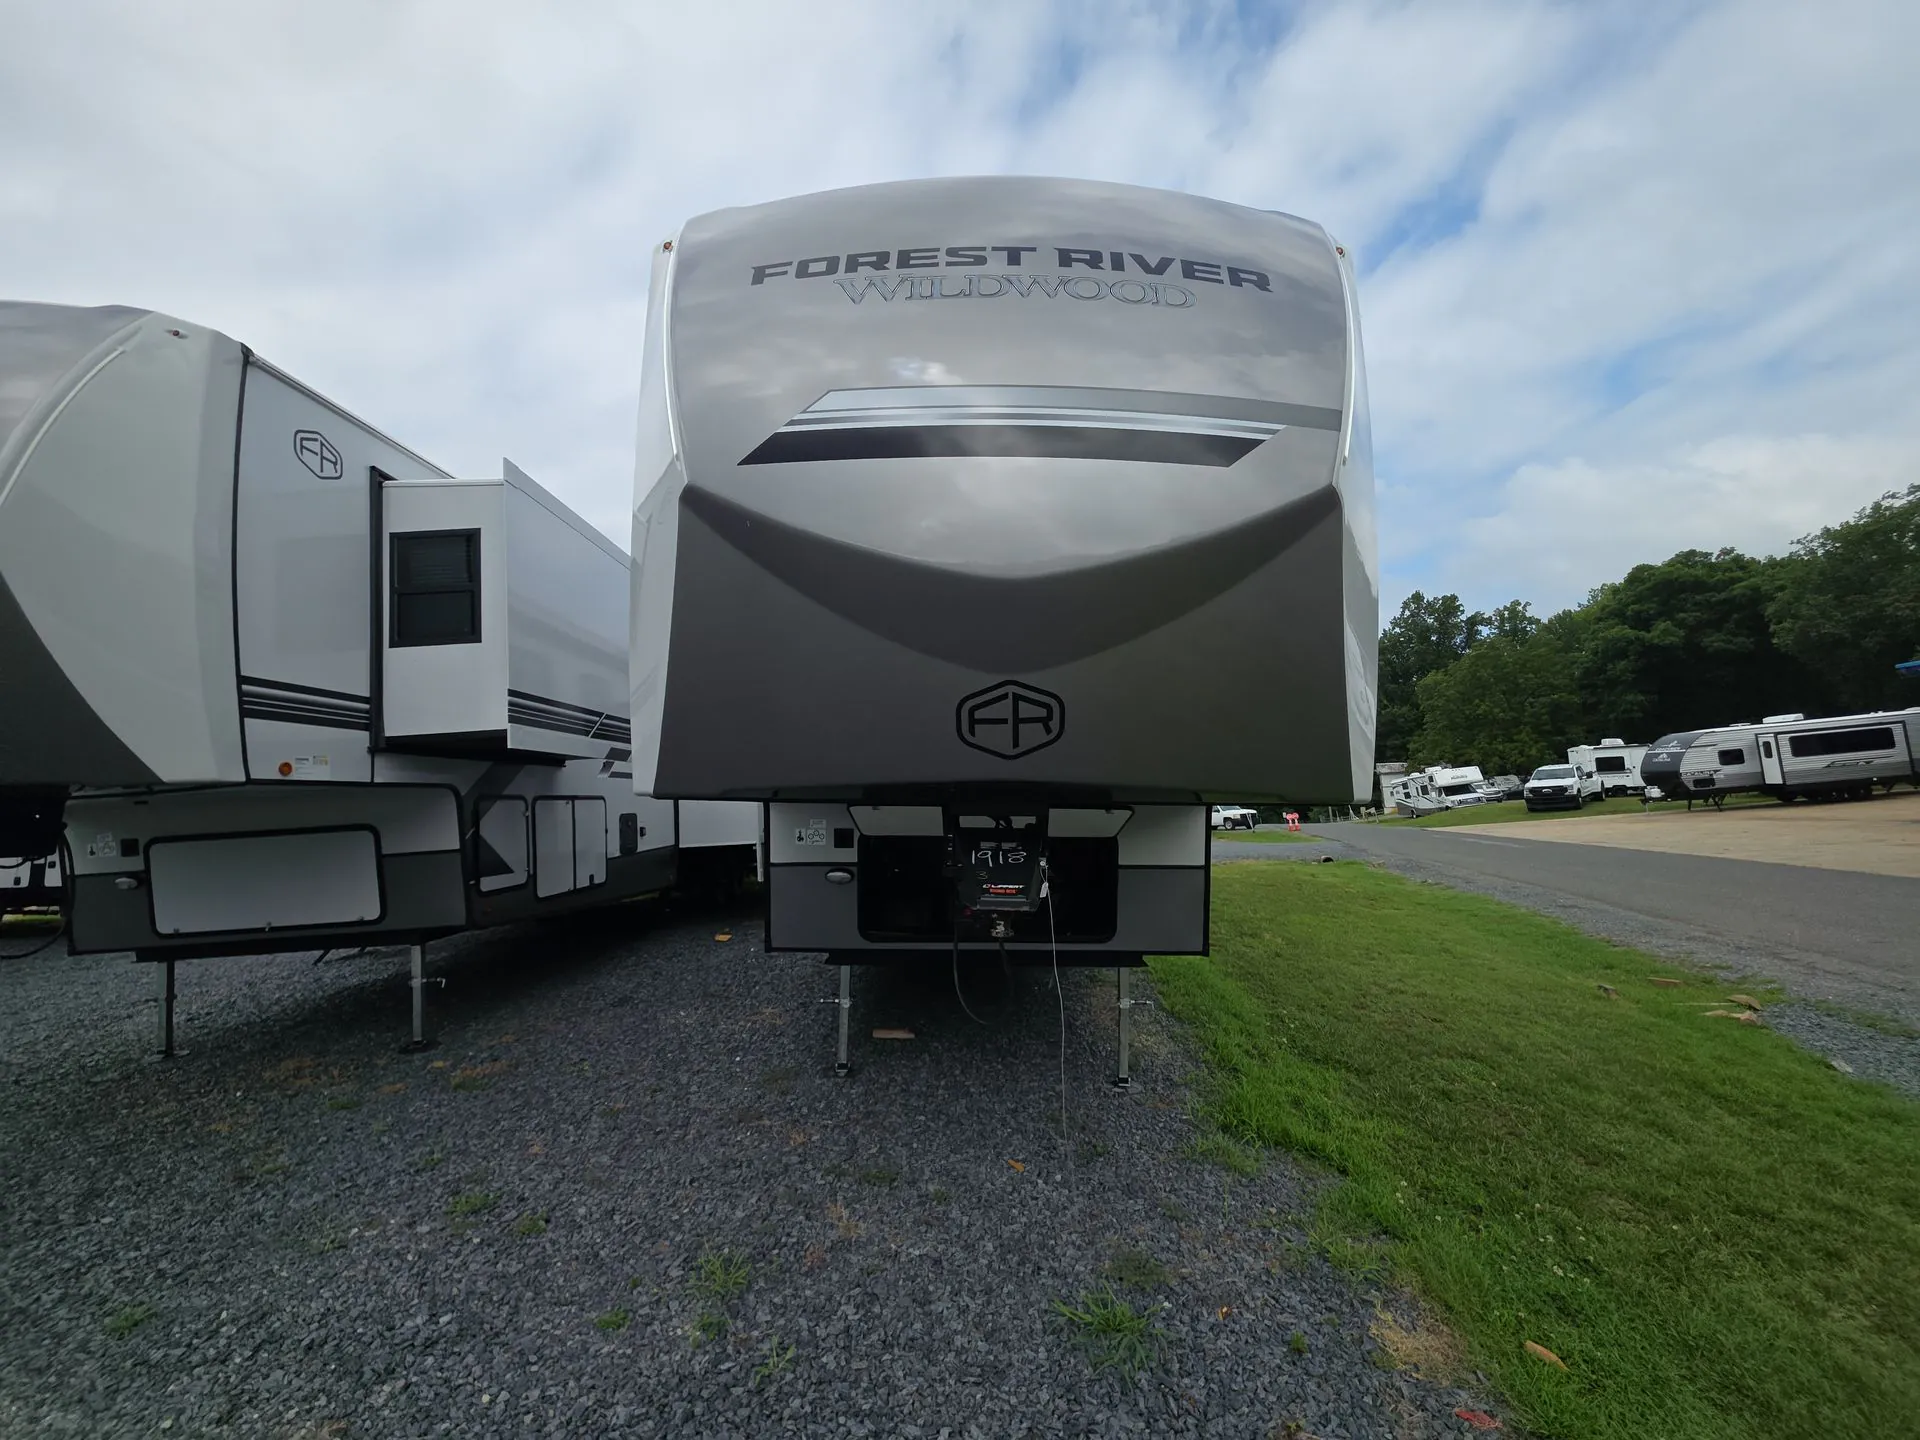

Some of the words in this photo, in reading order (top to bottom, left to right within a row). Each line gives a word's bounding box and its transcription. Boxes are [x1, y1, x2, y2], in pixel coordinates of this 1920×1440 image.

[751, 246, 1037, 286] FOREST
[1054, 247, 1273, 293] RIVER
[833, 272, 1198, 309] WILDWOOD
[971, 850, 1027, 868] 1918
